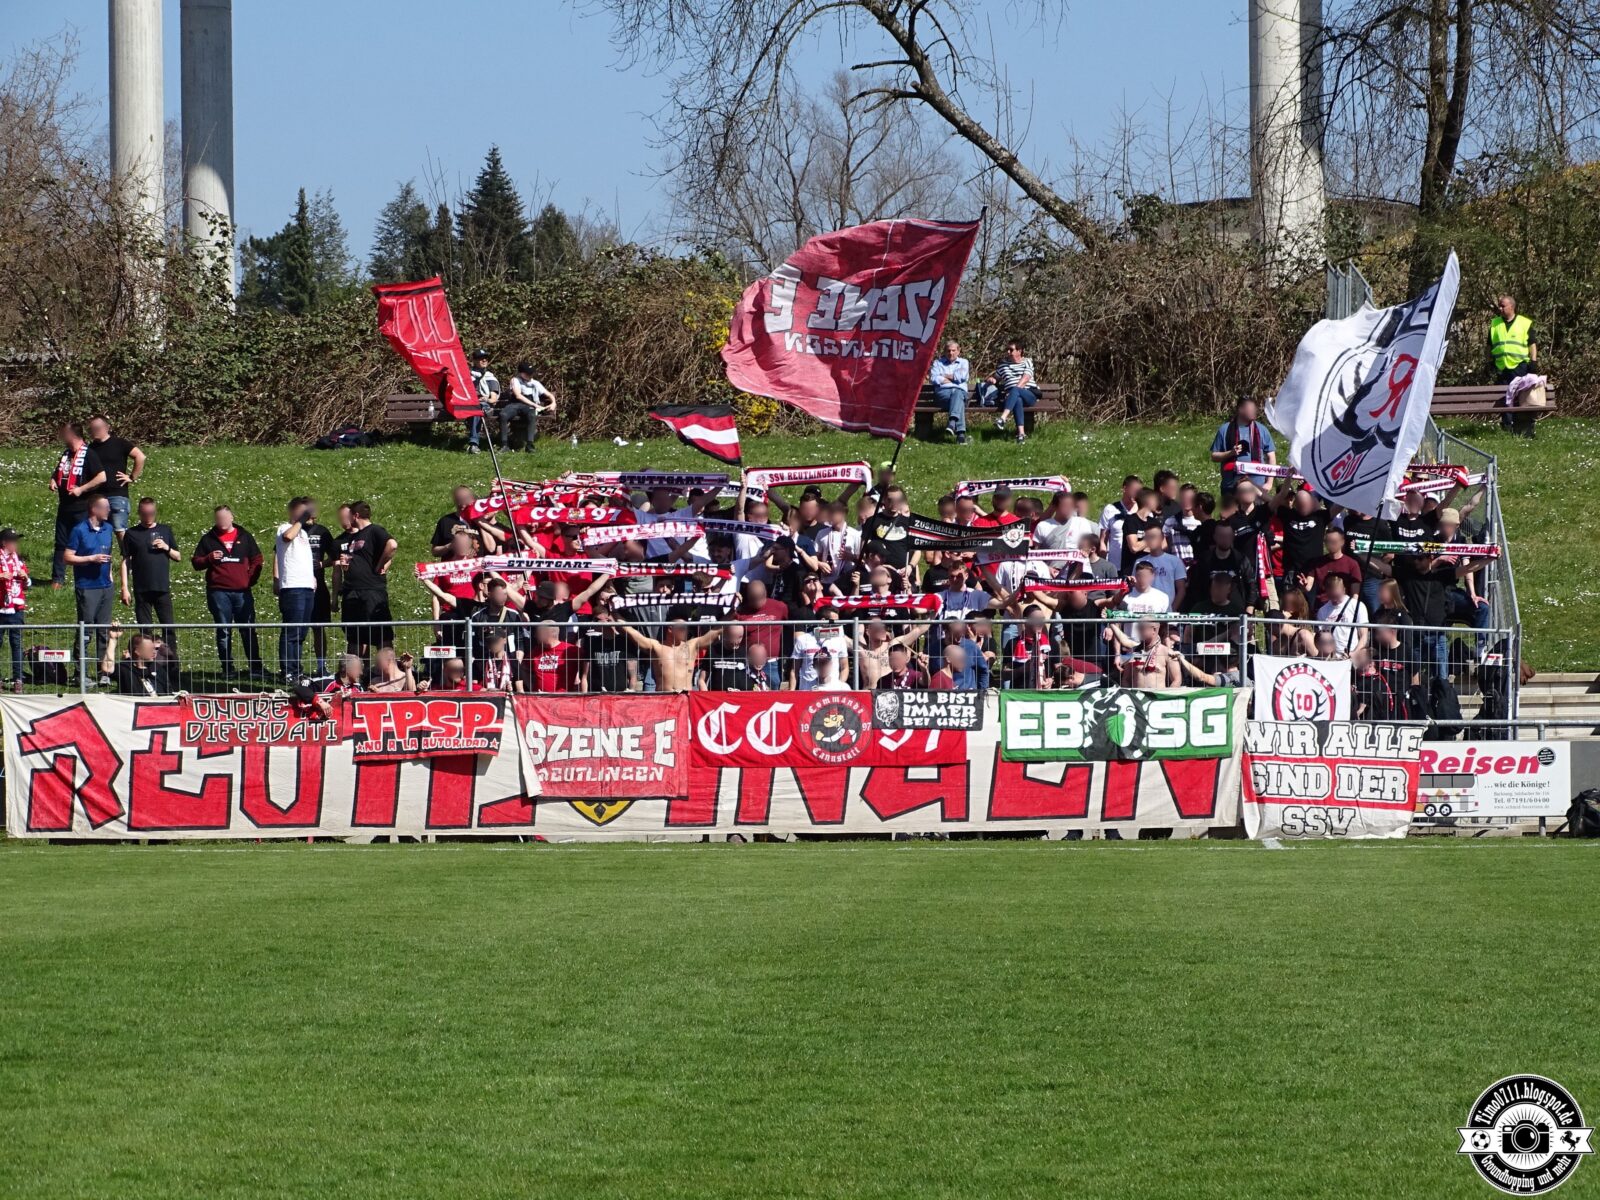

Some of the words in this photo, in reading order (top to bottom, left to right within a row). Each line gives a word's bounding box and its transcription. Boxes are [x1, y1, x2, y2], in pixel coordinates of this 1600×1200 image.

[769, 473, 785, 482] SSV
[787, 470, 837, 481] REUTLINGEN
[840, 467, 851, 478] 05
[474, 494, 503, 513] CC
[530, 507, 561, 520] CC
[591, 507, 622, 521] 97
[914, 519, 959, 536] ZUSAMMEN
[507, 559, 593, 569] STUTTGART
[620, 563, 658, 575] SEIT
[680, 563, 719, 576] 1905
[611, 592, 736, 610] REUTLINGEN
[831, 595, 863, 608] CC
[903, 692, 929, 704] DU
[937, 692, 978, 704] BIST
[192, 697, 288, 721] ONORE
[903, 704, 977, 718] IMMER
[355, 699, 498, 741] TPSP
[801, 723, 810, 733] 19
[862, 722, 872, 732] 97
[903, 717, 929, 727] BEI
[937, 717, 977, 727] UNS!
[185, 720, 338, 744] DIFFIDATI
[1244, 720, 1318, 756] WIR
[1324, 722, 1425, 761] ALLE
[363, 740, 382, 752] NO
[387, 739, 398, 752] A
[402, 737, 418, 750] LA
[422, 737, 488, 749] AUTORIDAD
[525, 719, 643, 766] SZENE
[653, 718, 676, 768] E
[1420, 747, 1540, 775] Reisen
[537, 766, 664, 783] REUTLINGEN
[1251, 762, 1331, 799] SIND
[1336, 765, 1408, 802] DER
[1281, 804, 1356, 837] SSV
